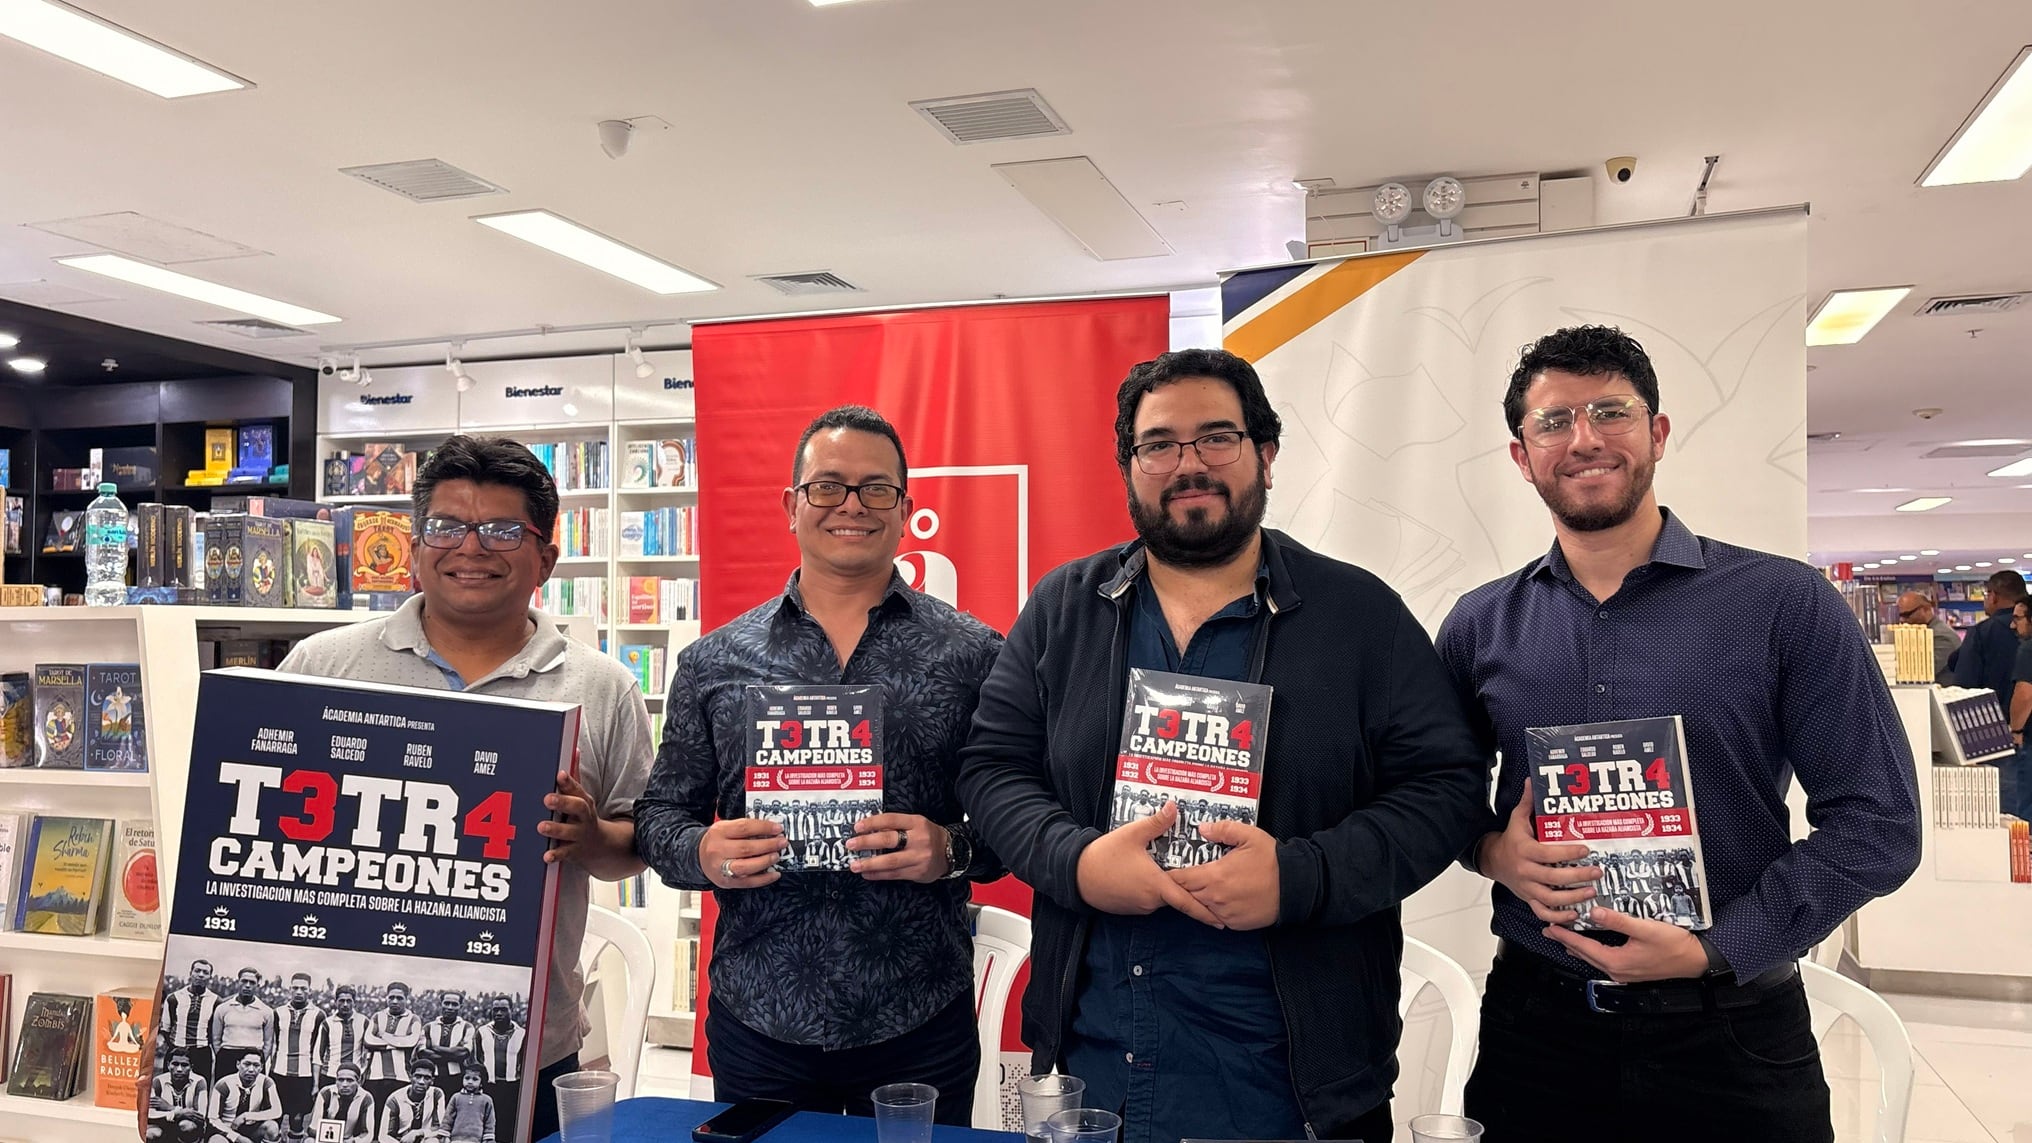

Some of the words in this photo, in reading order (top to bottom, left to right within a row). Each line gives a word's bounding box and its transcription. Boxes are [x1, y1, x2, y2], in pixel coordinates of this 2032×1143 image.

[664, 378, 694, 389] Bien
[505, 385, 564, 398] Bienestar
[360, 394, 413, 405] Bienestar
[38, 676, 82, 686] MARSELLA
[100, 672, 136, 684] TAROT
[407, 720, 434, 731] PRESENTA
[1134, 705, 1253, 749] T3TR4
[257, 728, 294, 742] ADHEMIR
[756, 720, 872, 748] T3TR4
[251, 739, 298, 755] FANARRAGA
[331, 735, 367, 750] EDUARDO
[95, 749, 136, 761] FLORAL
[330, 747, 365, 762] SALCEDO
[474, 750, 498, 764] DAVID
[756, 749, 872, 765] CAMPEONES
[1130, 736, 1250, 767] CAMPEONES
[403, 755, 432, 769] RAVELO
[473, 762, 496, 776] AMEZ
[1121, 770, 1139, 779] 1932
[1539, 758, 1670, 796] T3TR4
[1230, 785, 1248, 794] 1934
[1543, 791, 1674, 814] CAMPEONES
[219, 762, 516, 860] T3TR4
[1544, 820, 1561, 829] 1931
[1660, 815, 1681, 823] 1933
[125, 827, 133, 837] El
[1545, 830, 1563, 838] 1932
[1662, 824, 1682, 832] 1934
[129, 838, 138, 847] de
[53, 840, 89, 861] Sharma
[208, 837, 511, 902] CAMPEONES
[206, 880, 217, 895] LA
[219, 881, 292, 901] INVESTIGACIÓN
[293, 888, 316, 904] MÁS
[317, 890, 367, 909] COMPLETA
[368, 895, 400, 912] SOBRE
[401, 899, 412, 913] LA
[414, 900, 451, 917] HAZAÑA
[452, 904, 507, 922] ALIANCISTA
[204, 916, 236, 931] 1931
[292, 925, 326, 939] 1932
[382, 933, 416, 948] 1933
[466, 941, 500, 956] 1934
